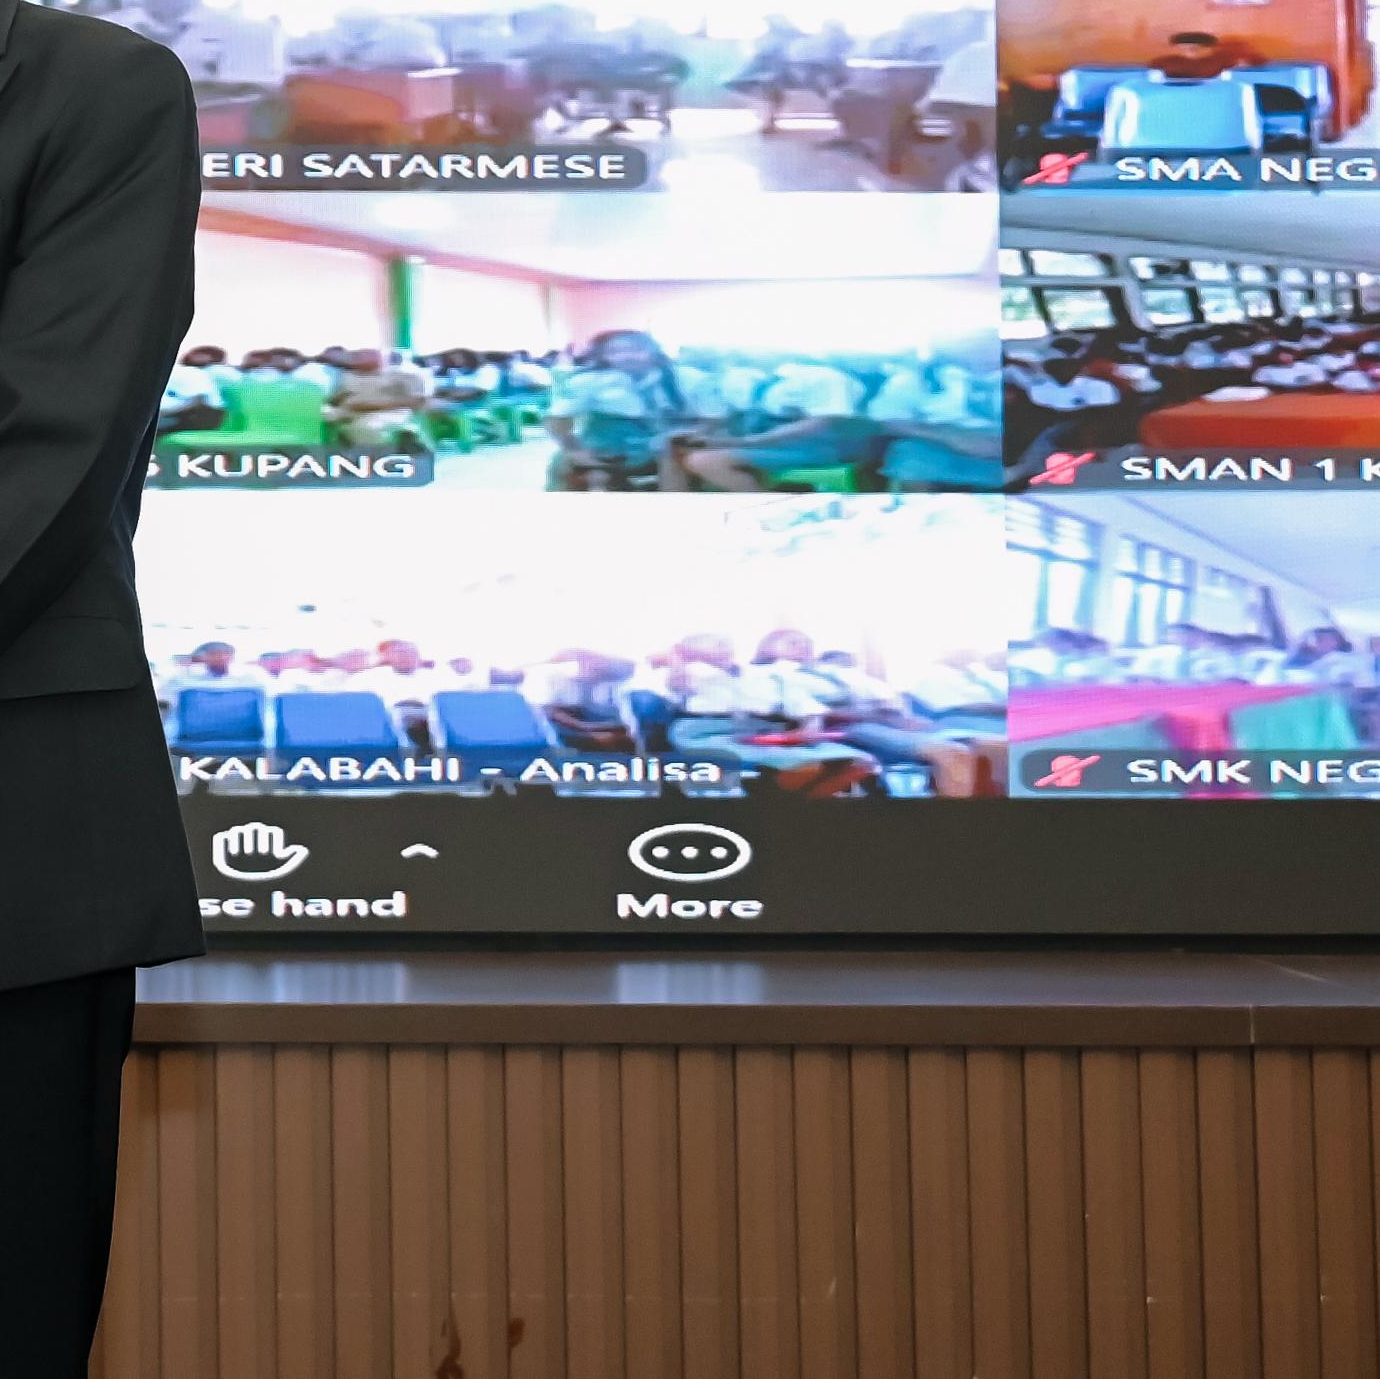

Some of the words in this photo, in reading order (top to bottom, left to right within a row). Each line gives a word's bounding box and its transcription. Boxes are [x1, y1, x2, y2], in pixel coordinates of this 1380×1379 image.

[201, 151, 284, 179] ERI
[303, 151, 626, 181] SATARMESE
[1116, 154, 1243, 184] SMA
[176, 452, 415, 480] KUPANG
[1121, 455, 1292, 483] SMAN
[1313, 456, 1334, 483] 1
[180, 753, 460, 783] KALABAHI
[519, 751, 722, 785] Analisa
[1128, 757, 1254, 786] SMK
[200, 891, 256, 920] se
[273, 890, 407, 921] hand
[616, 890, 763, 921] More
